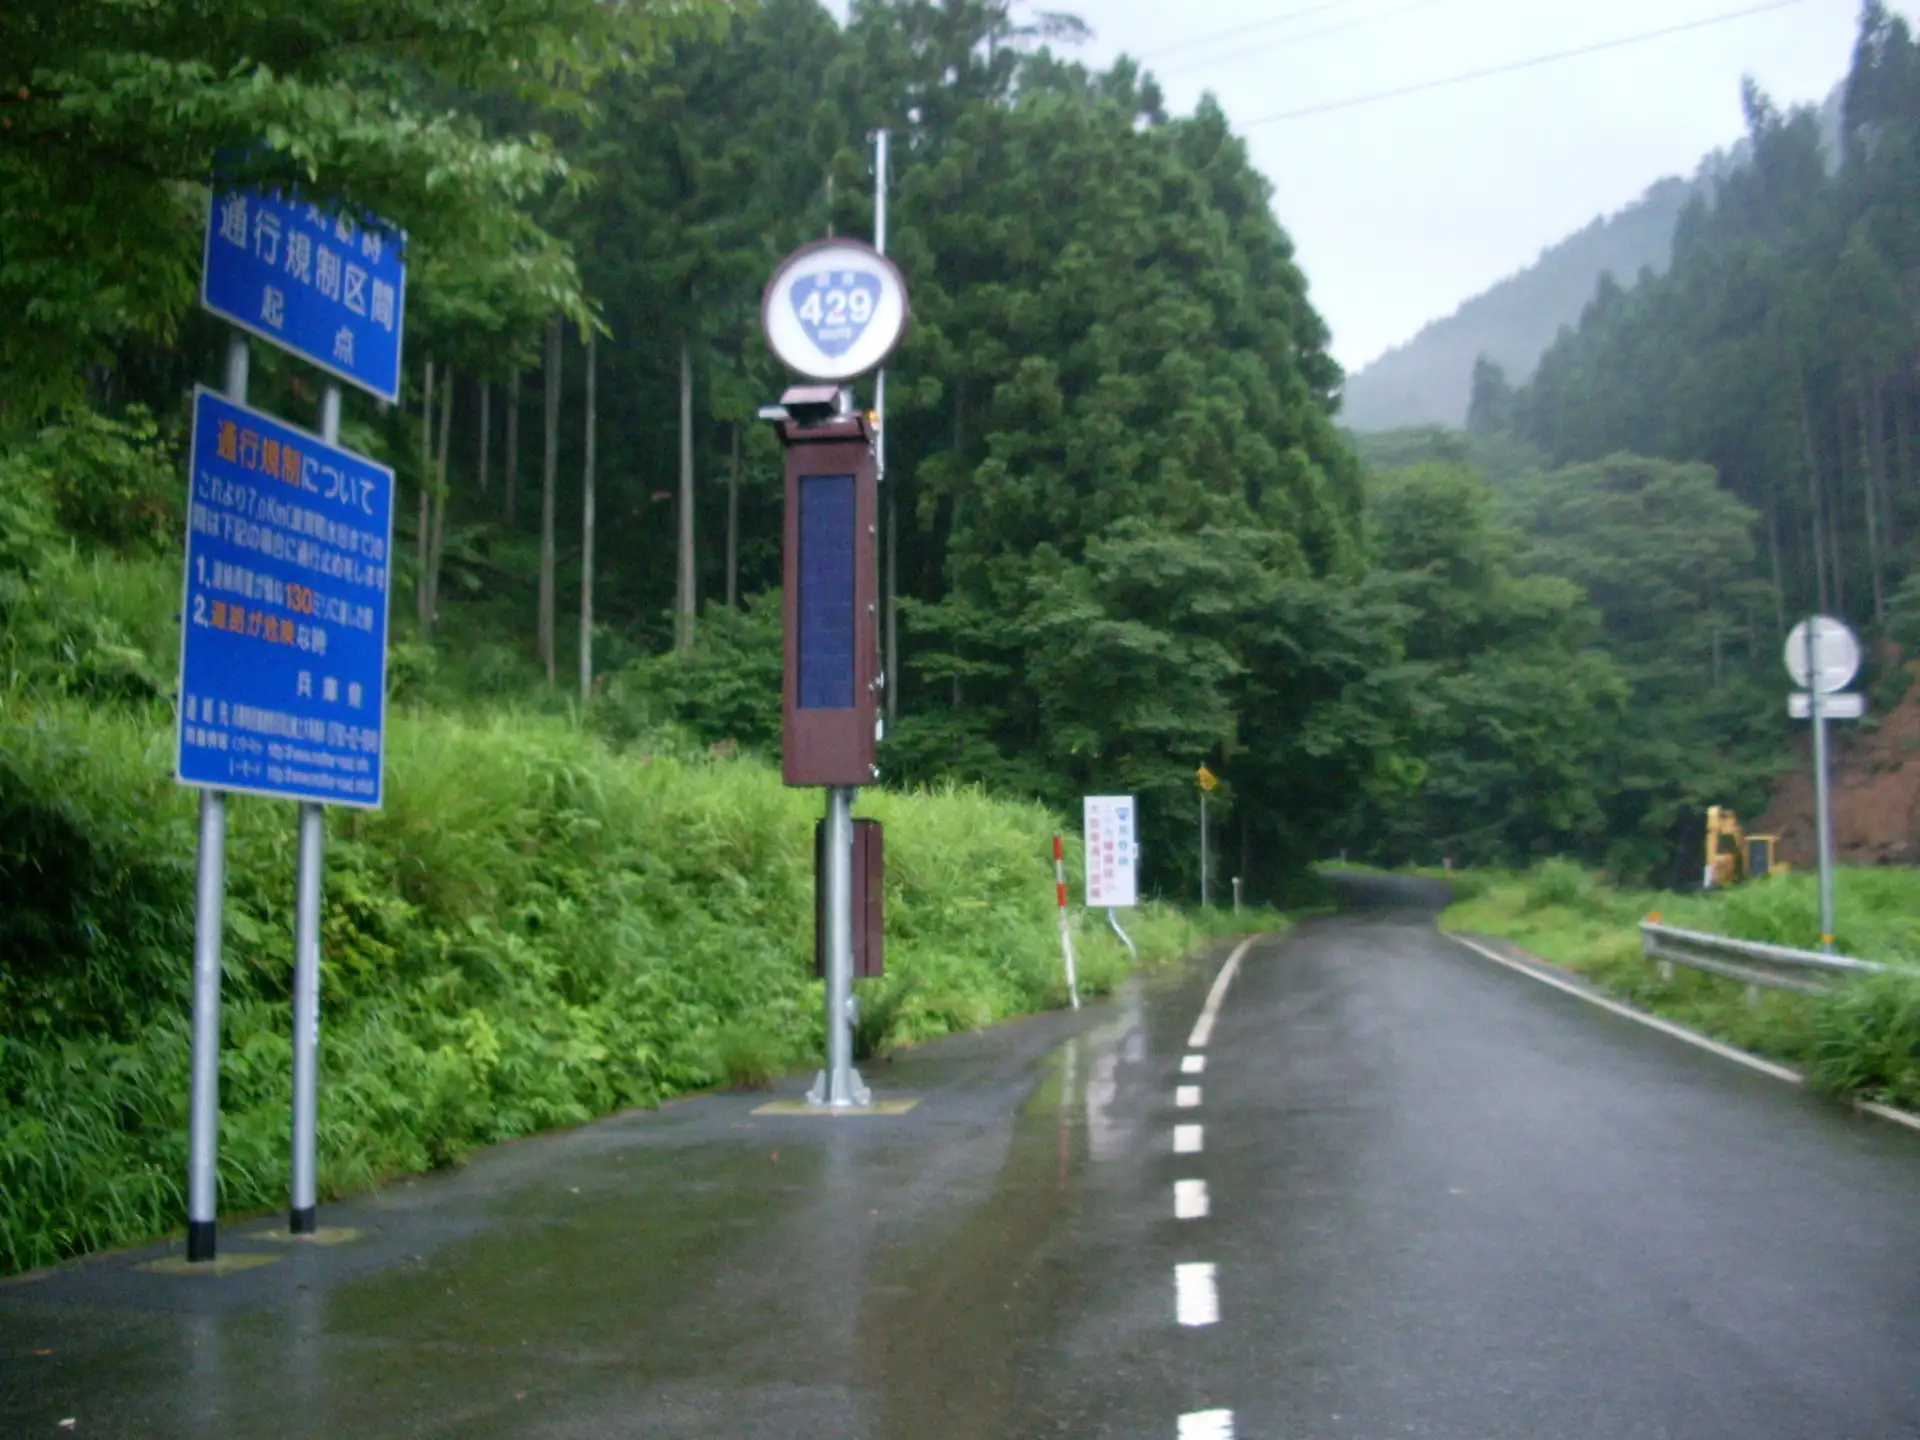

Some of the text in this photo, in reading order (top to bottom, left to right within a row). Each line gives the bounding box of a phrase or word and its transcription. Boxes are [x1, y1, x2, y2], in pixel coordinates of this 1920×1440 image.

[219, 197, 394, 332] 通行規制区間
[800, 288, 872, 326] 429
[217, 418, 376, 515] 通行規制について
